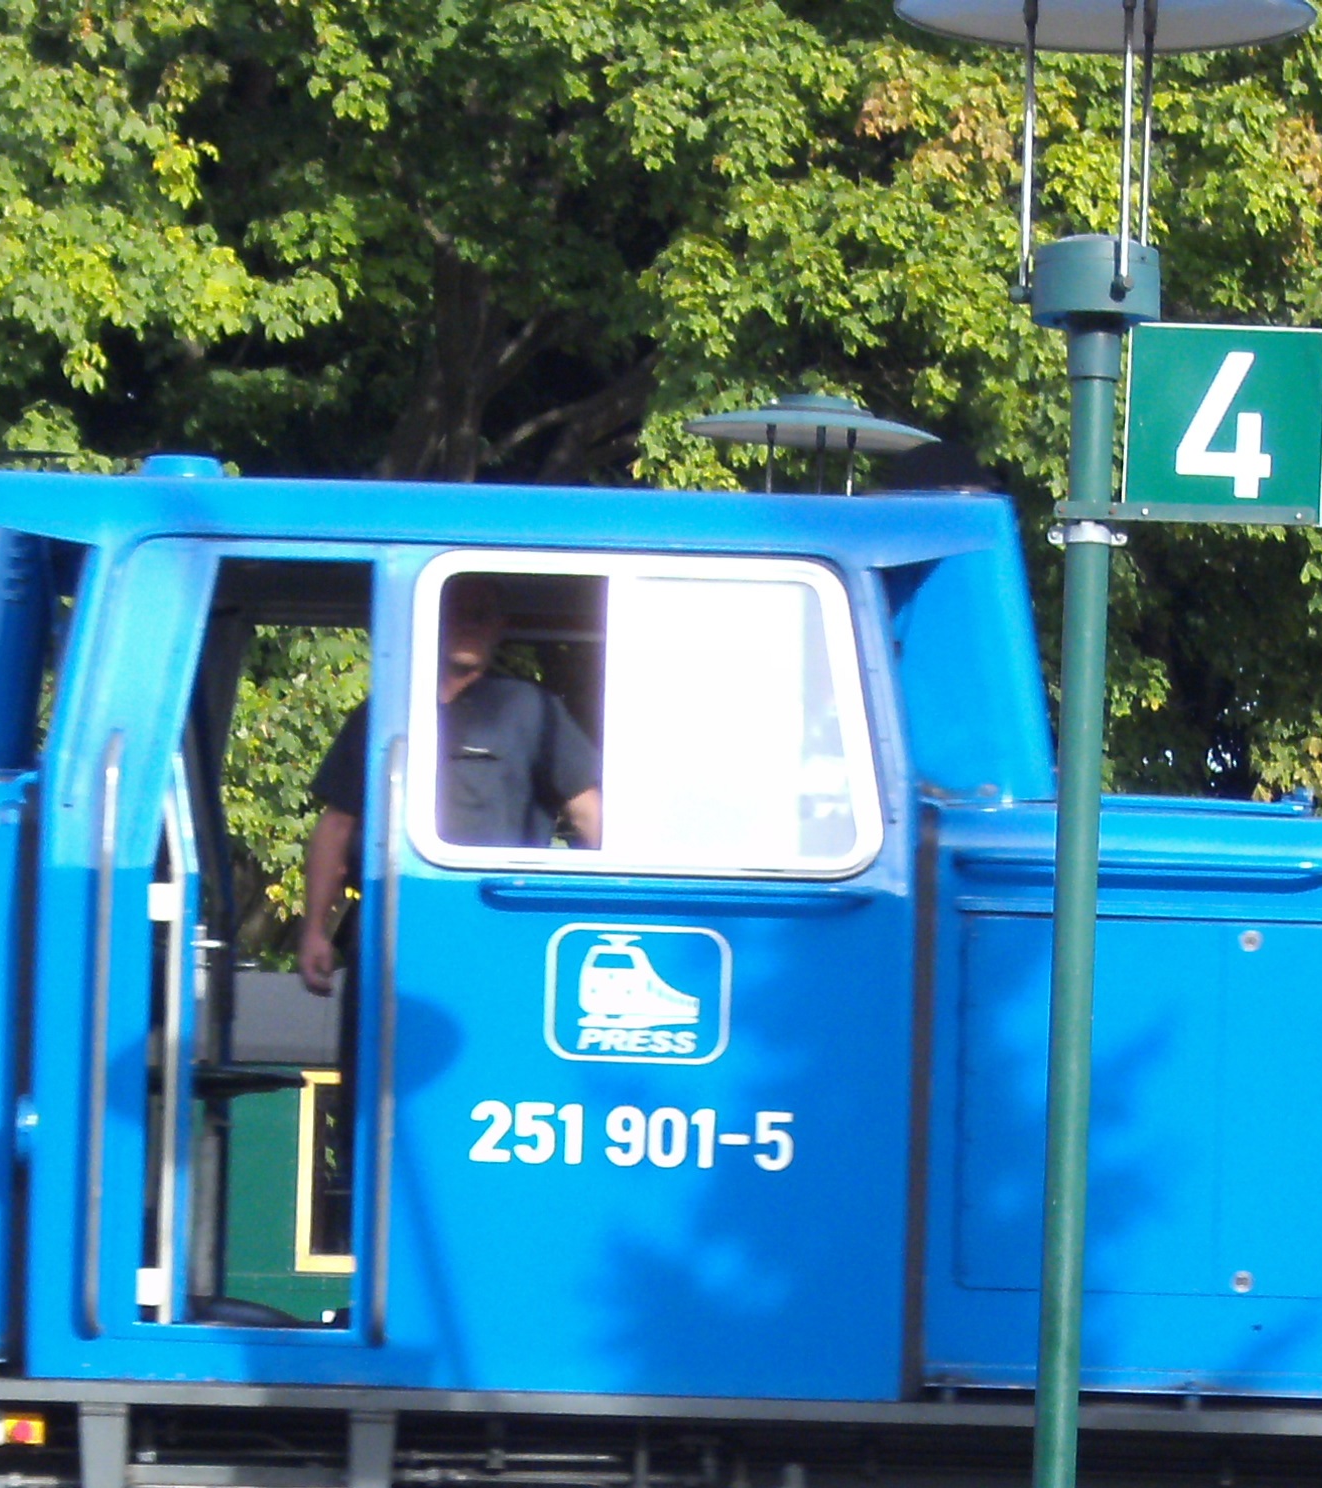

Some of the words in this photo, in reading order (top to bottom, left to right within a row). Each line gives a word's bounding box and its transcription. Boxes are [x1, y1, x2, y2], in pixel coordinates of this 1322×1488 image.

[1175, 351, 1272, 499] 4
[577, 1027, 698, 1054] PRESS
[469, 1100, 584, 1164] 251
[605, 1105, 794, 1171] 901-5
